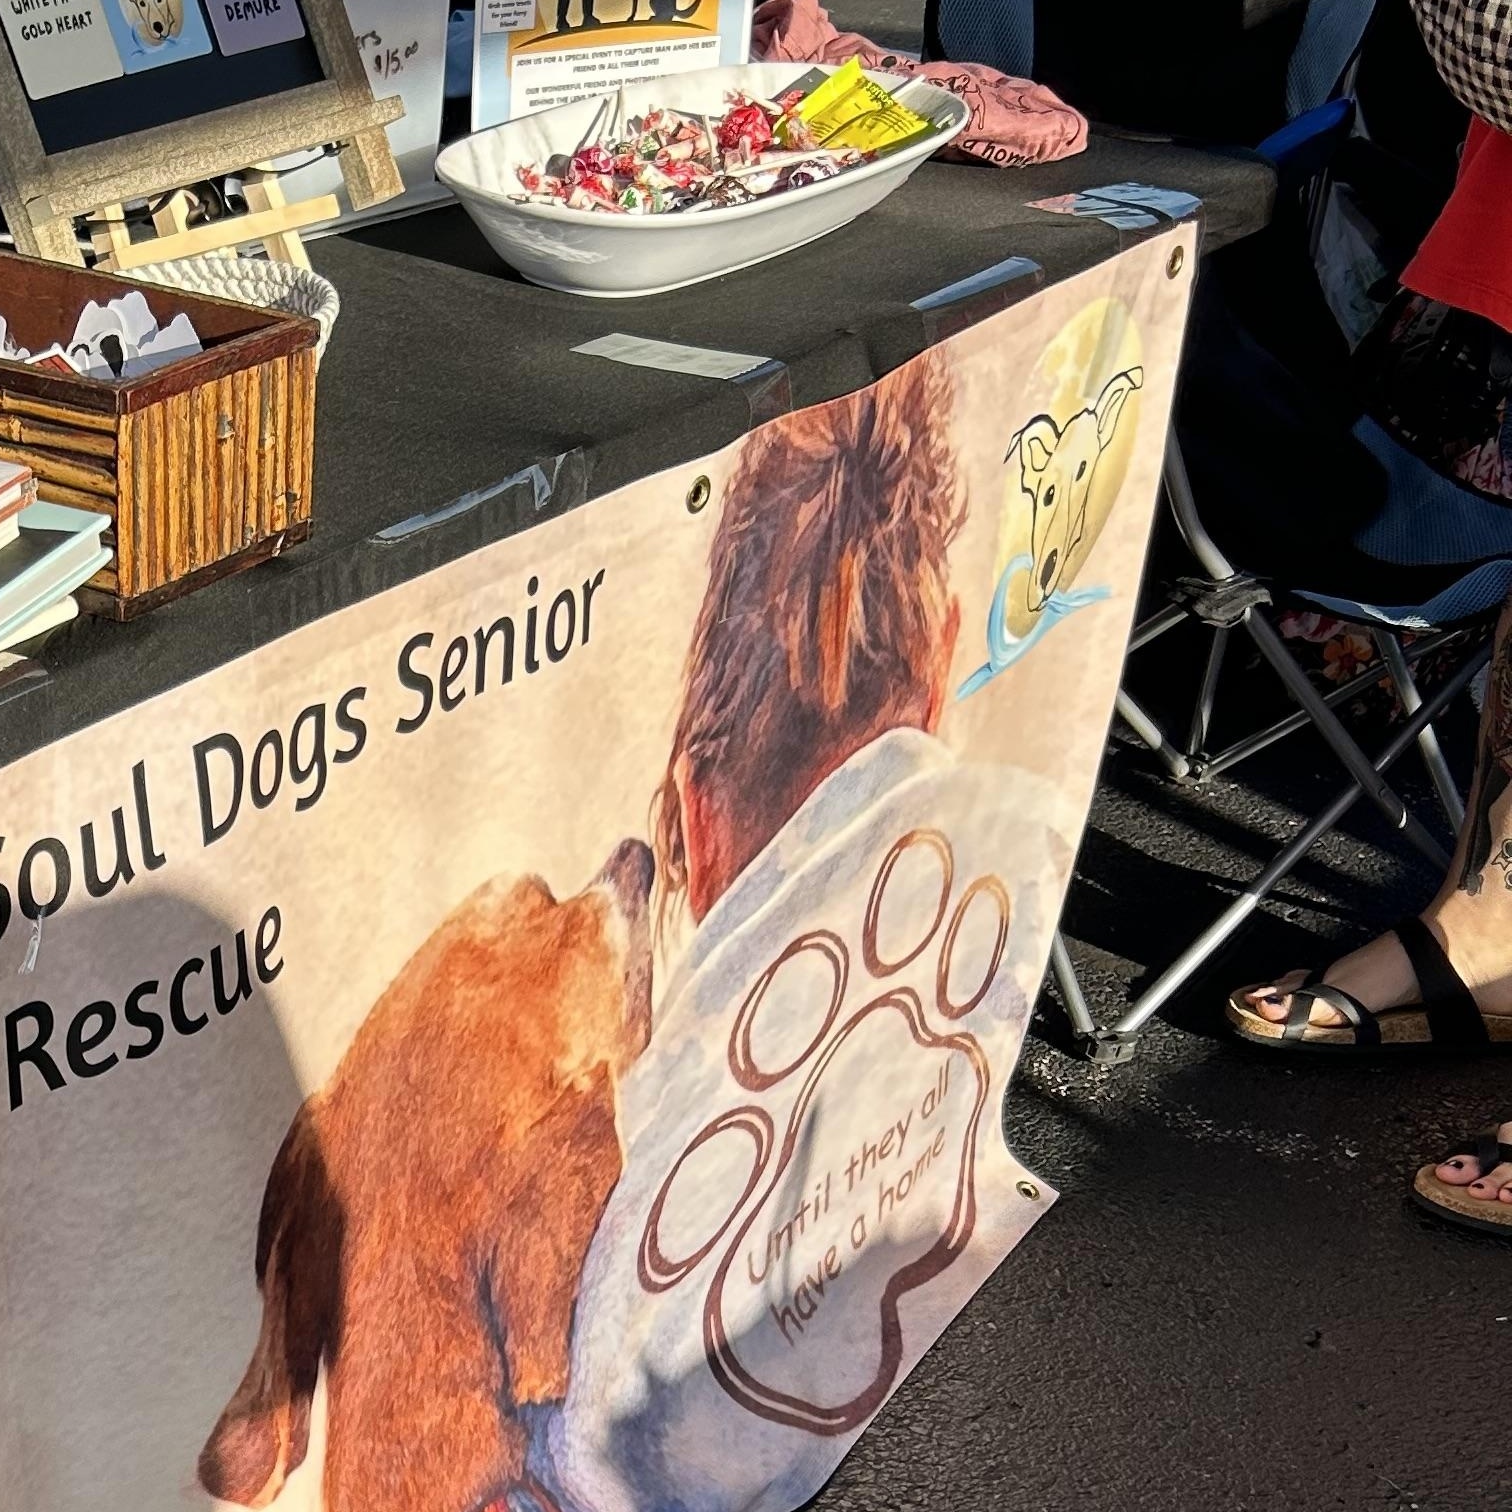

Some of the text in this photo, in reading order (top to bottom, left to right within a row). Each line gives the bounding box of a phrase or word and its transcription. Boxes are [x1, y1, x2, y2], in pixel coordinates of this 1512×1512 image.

[21, 11, 93, 41] GOLD HEART
[224, 0, 281, 22] DEMURE
[672, 44, 687, 52] AND
[963, 140, 976, 152] a
[193, 685, 368, 847] Dogs
[394, 567, 607, 735] Senior
[3, 904, 286, 1112] Rescue
[748, 1058, 951, 1285] Until they all
[769, 1126, 946, 1347] have a home
